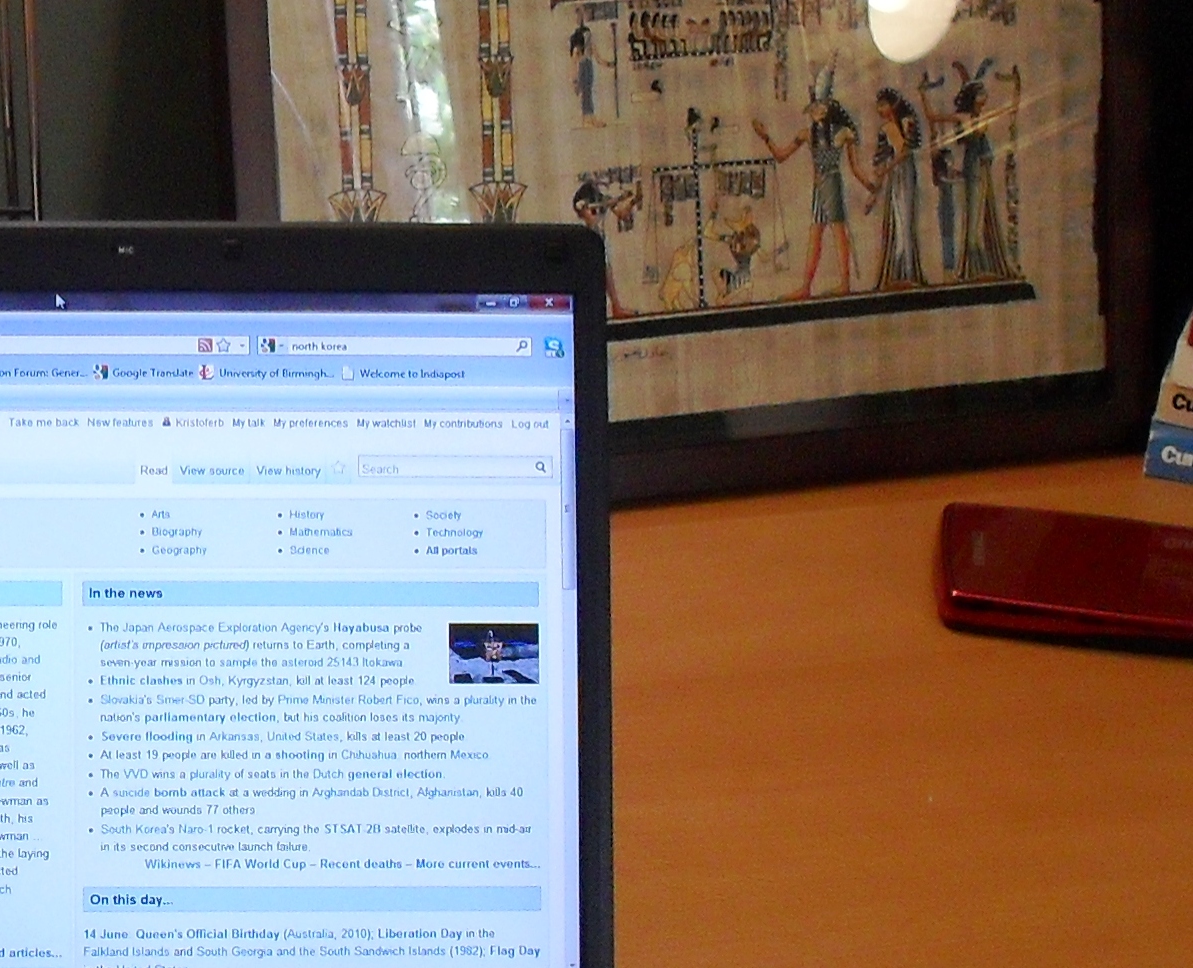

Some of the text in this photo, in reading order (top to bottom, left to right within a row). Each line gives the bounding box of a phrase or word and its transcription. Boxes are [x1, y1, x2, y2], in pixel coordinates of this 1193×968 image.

[291, 341, 348, 352] north korea
[112, 367, 194, 381] Google Translate
[219, 367, 268, 381] University
[269, 368, 280, 378] of
[359, 368, 466, 382] Welcome to Indiapost
[9, 417, 80, 428] Take me back
[87, 417, 154, 428] New features
[175, 417, 225, 428] Kristoferb
[232, 418, 265, 429] My talk
[273, 417, 349, 430] My preferences
[356, 418, 416, 430] My watchlist
[423, 418, 503, 430] My contributions
[511, 419, 549, 431] Log out
[140, 464, 168, 476] Read
[179, 465, 245, 476] View source
[256, 465, 322, 480] View history
[361, 464, 401, 477] Search
[151, 509, 171, 520] Arts
[289, 509, 325, 521] History
[425, 510, 462, 522] Society
[151, 526, 203, 539] Biography
[289, 527, 353, 537] Mathematics
[426, 527, 484, 539] Technology
[151, 545, 207, 557] Geography
[289, 545, 330, 555] Science
[425, 545, 478, 557] All portals
[89, 587, 163, 599] In the news
[38, 619, 58, 630] role
[100, 621, 423, 636] The Japan Aerospace Exploration Agency's Hayabusa probe
[89, 893, 109, 906] On
[112, 893, 137, 906] this
